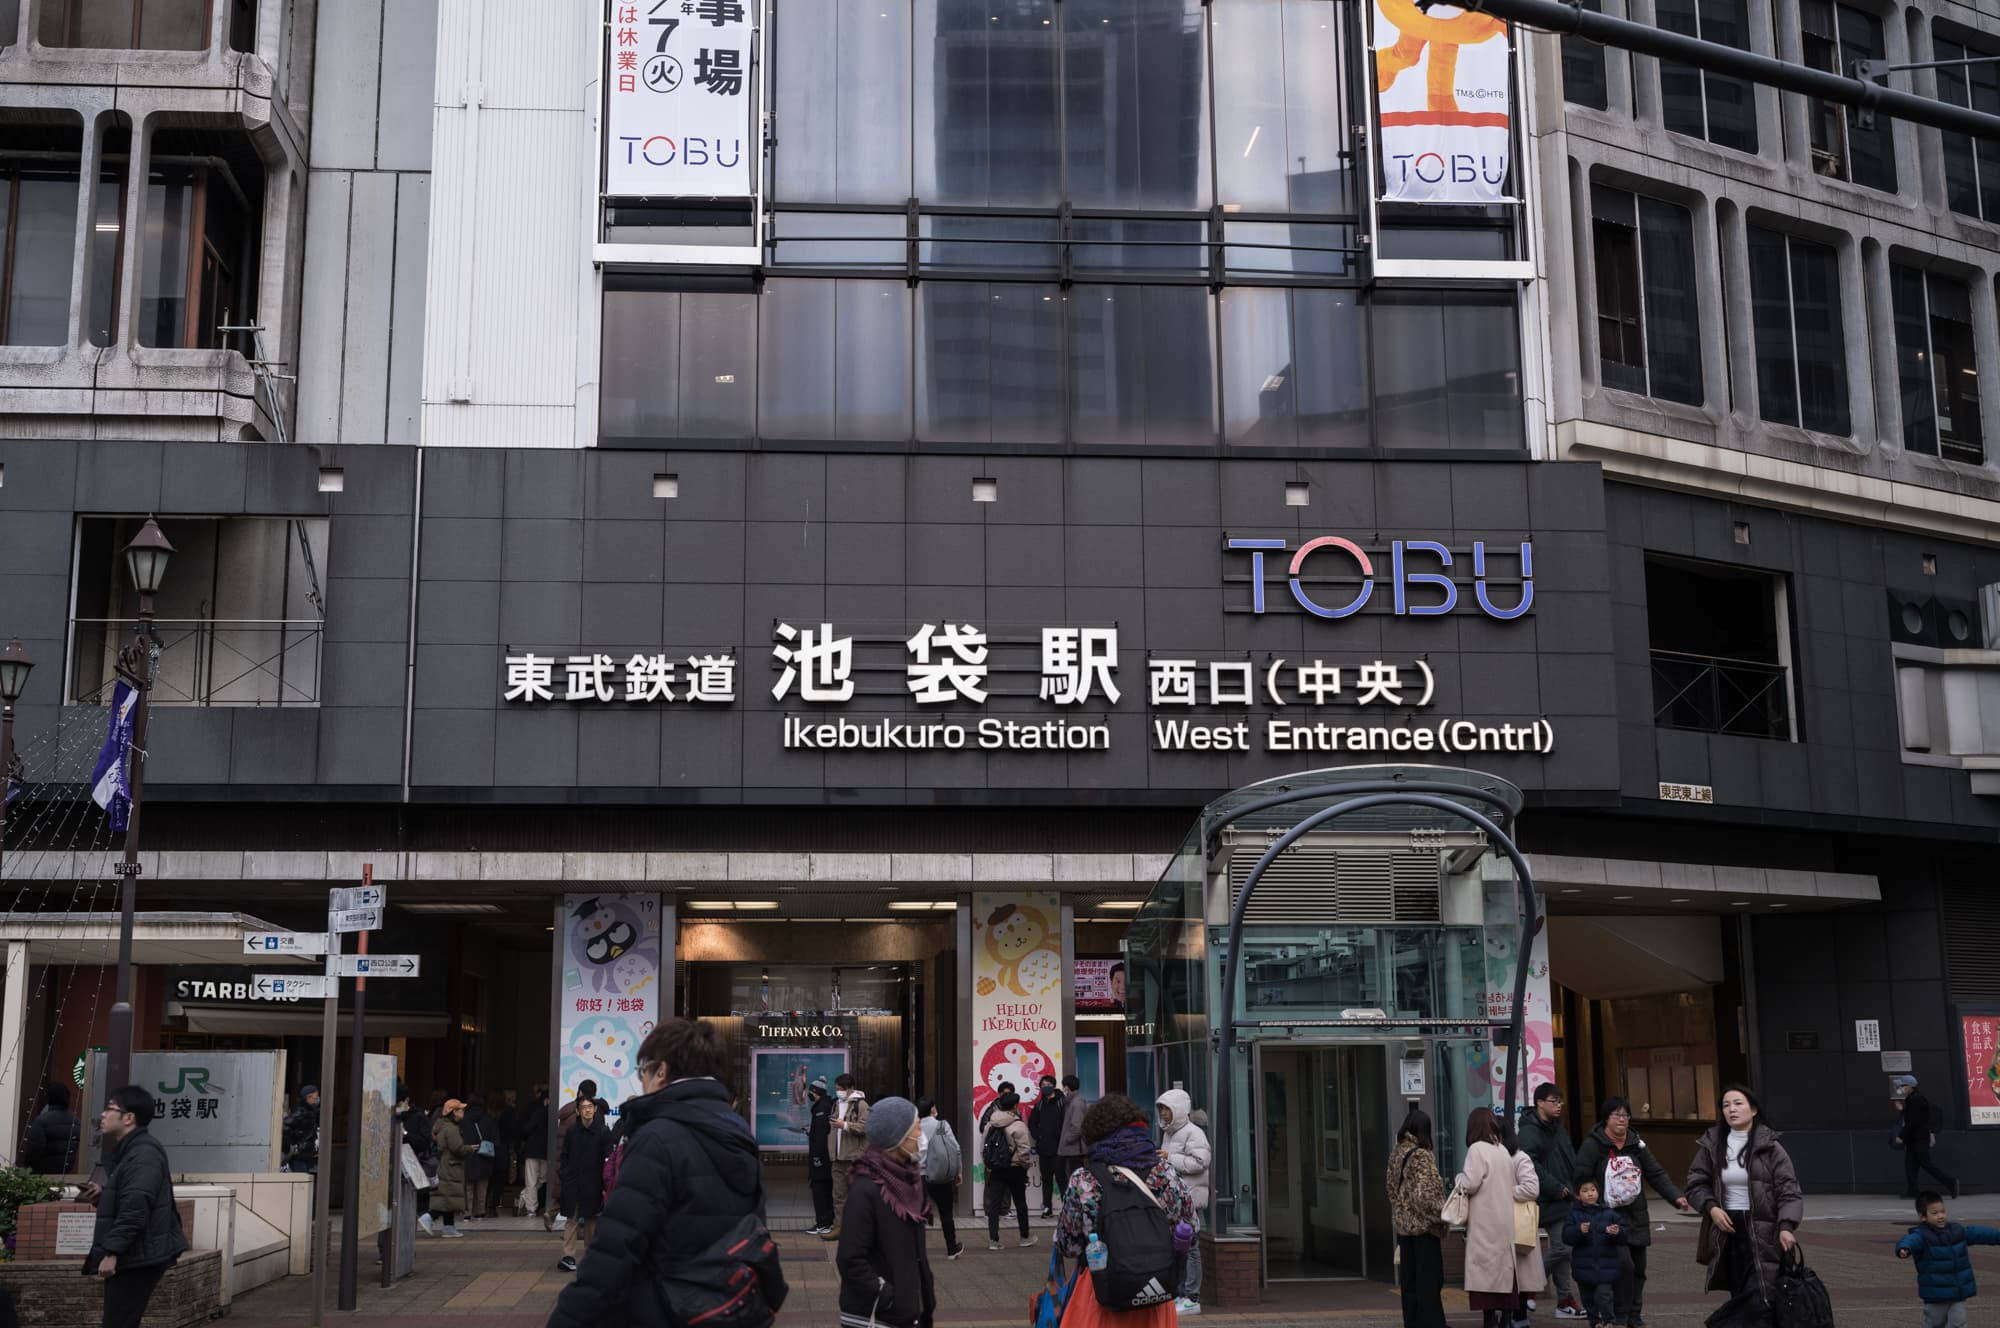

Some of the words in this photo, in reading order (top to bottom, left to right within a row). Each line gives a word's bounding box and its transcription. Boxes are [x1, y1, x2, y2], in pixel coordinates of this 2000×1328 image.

[619, 135, 739, 168] TOBU
[1393, 152, 1503, 185] TOBU
[1227, 535, 1535, 620] TOBU
[504, 653, 737, 703] 東武鉄道
[771, 622, 1121, 706] 池袋駅
[783, 717, 966, 748] Ikebukuro
[978, 717, 1111, 750] Station
[1154, 719, 1250, 751] West
[1267, 718, 1555, 754] Entrance(Cntrl)
[982, 1016, 1057, 1032] IKEBUKURO
[996, 1003, 1042, 1017] HELLO!
[758, 1024, 810, 1037] TIFFANY
[1981, 1021, 1993, 1050] 東武
[1971, 1020, 1984, 1089] 食品フロア
[158, 1067, 211, 1094] JR
